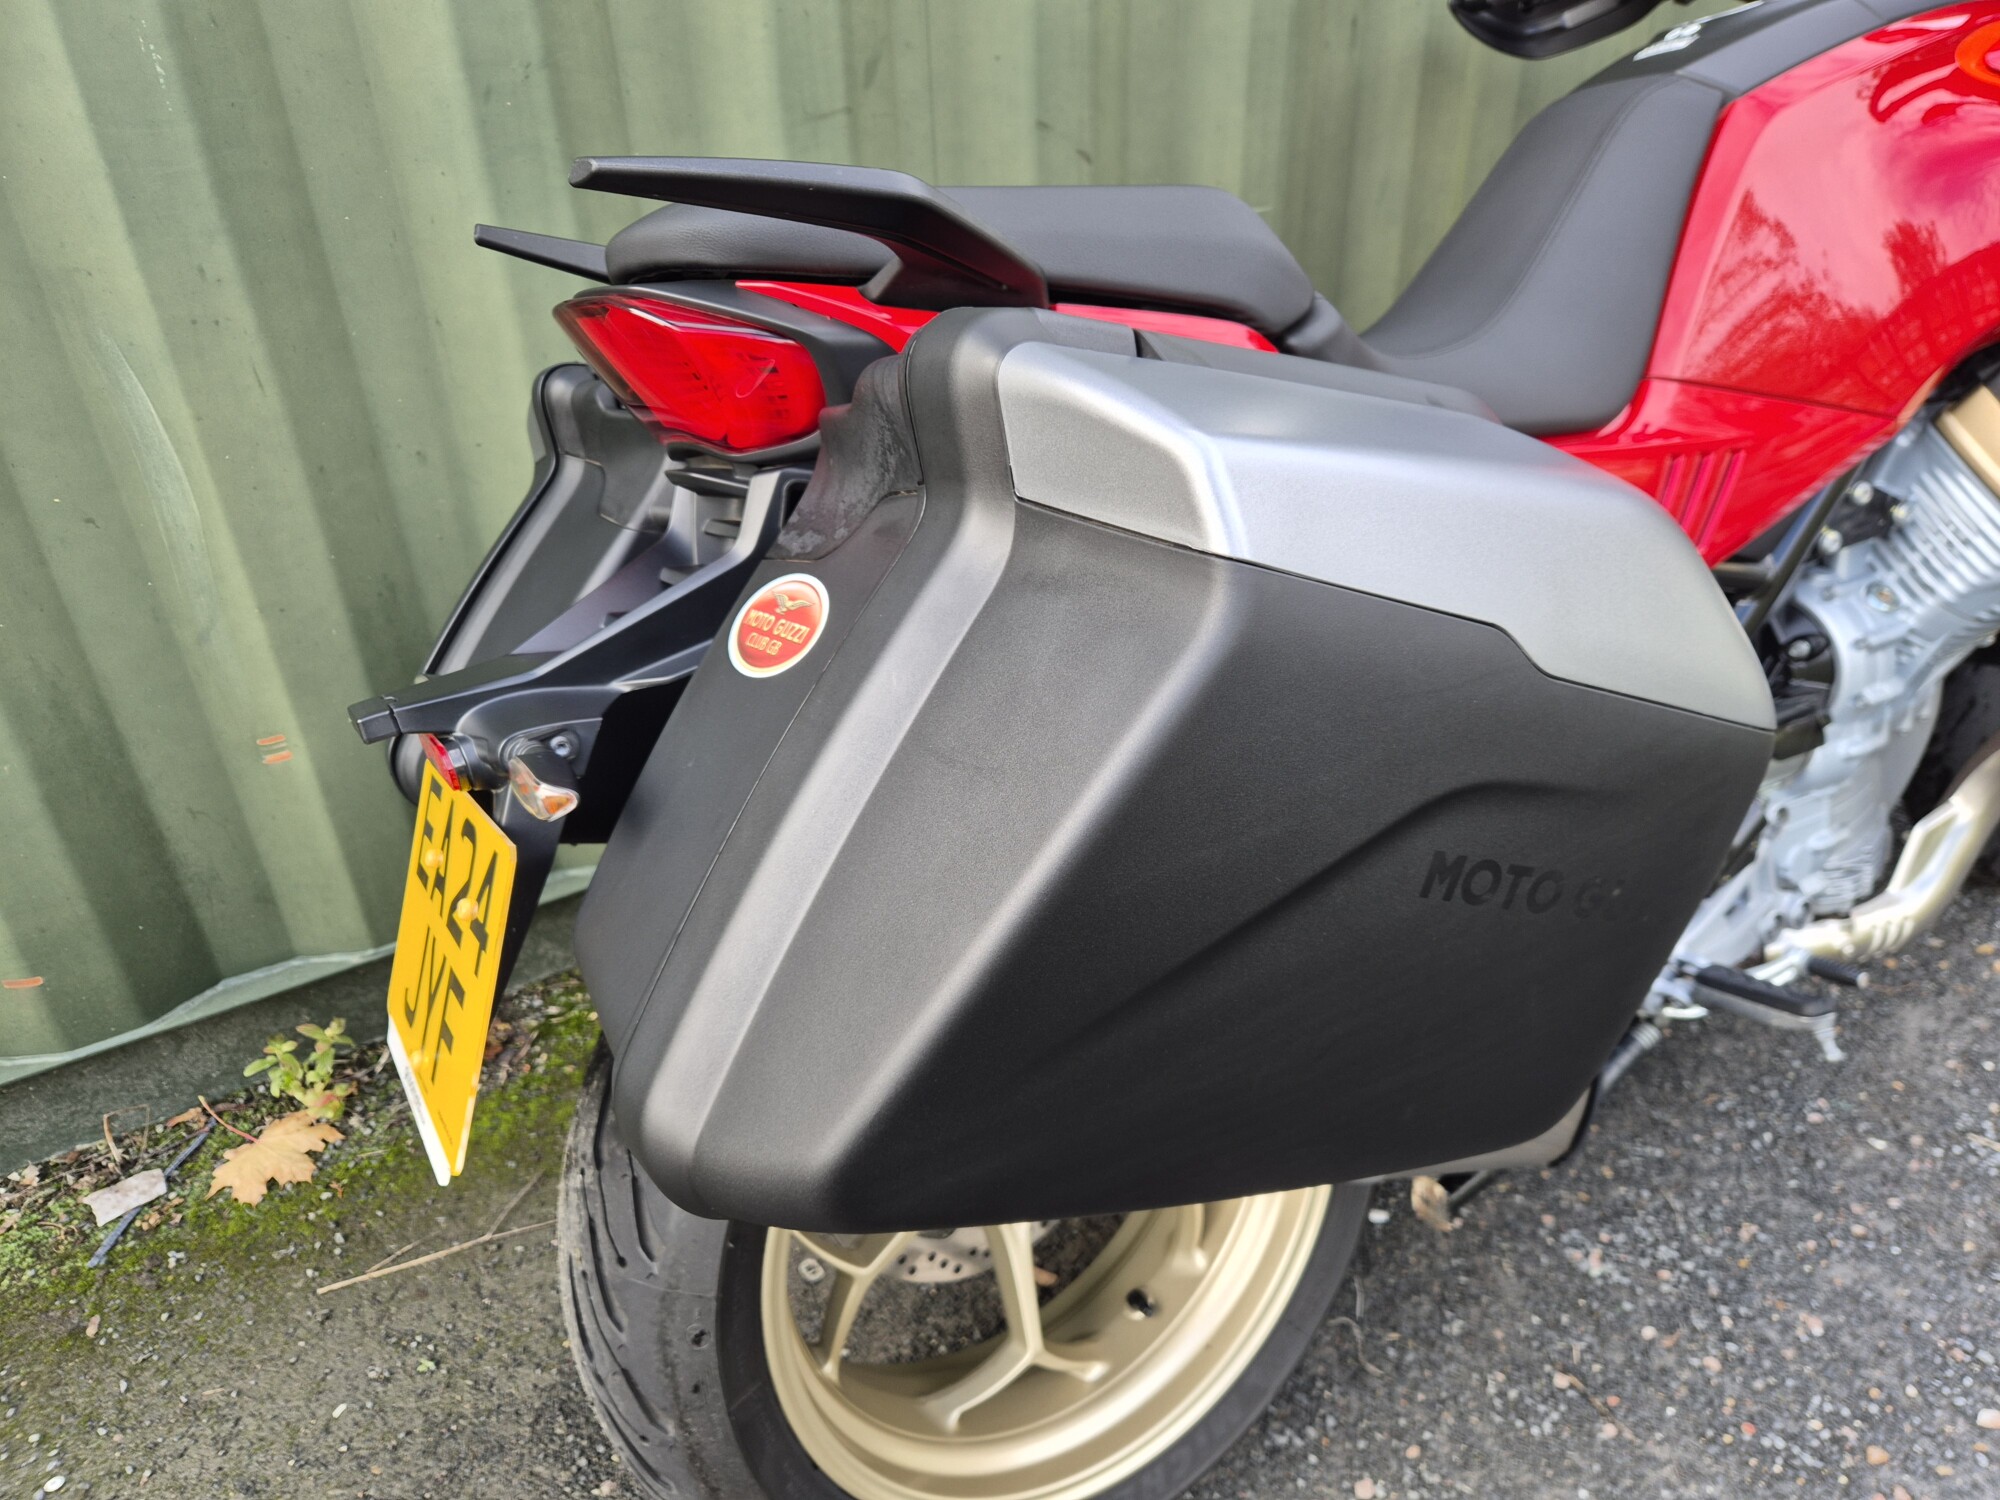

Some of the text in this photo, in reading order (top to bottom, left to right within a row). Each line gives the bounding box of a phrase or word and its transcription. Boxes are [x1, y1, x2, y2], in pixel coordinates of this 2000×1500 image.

[745, 610, 810, 644] MOTO GUZZI
[746, 633, 769, 651] CLUB
[417, 774, 497, 977] EA24
[1419, 850, 1565, 914] MOTO
[404, 924, 466, 1084] JYF
